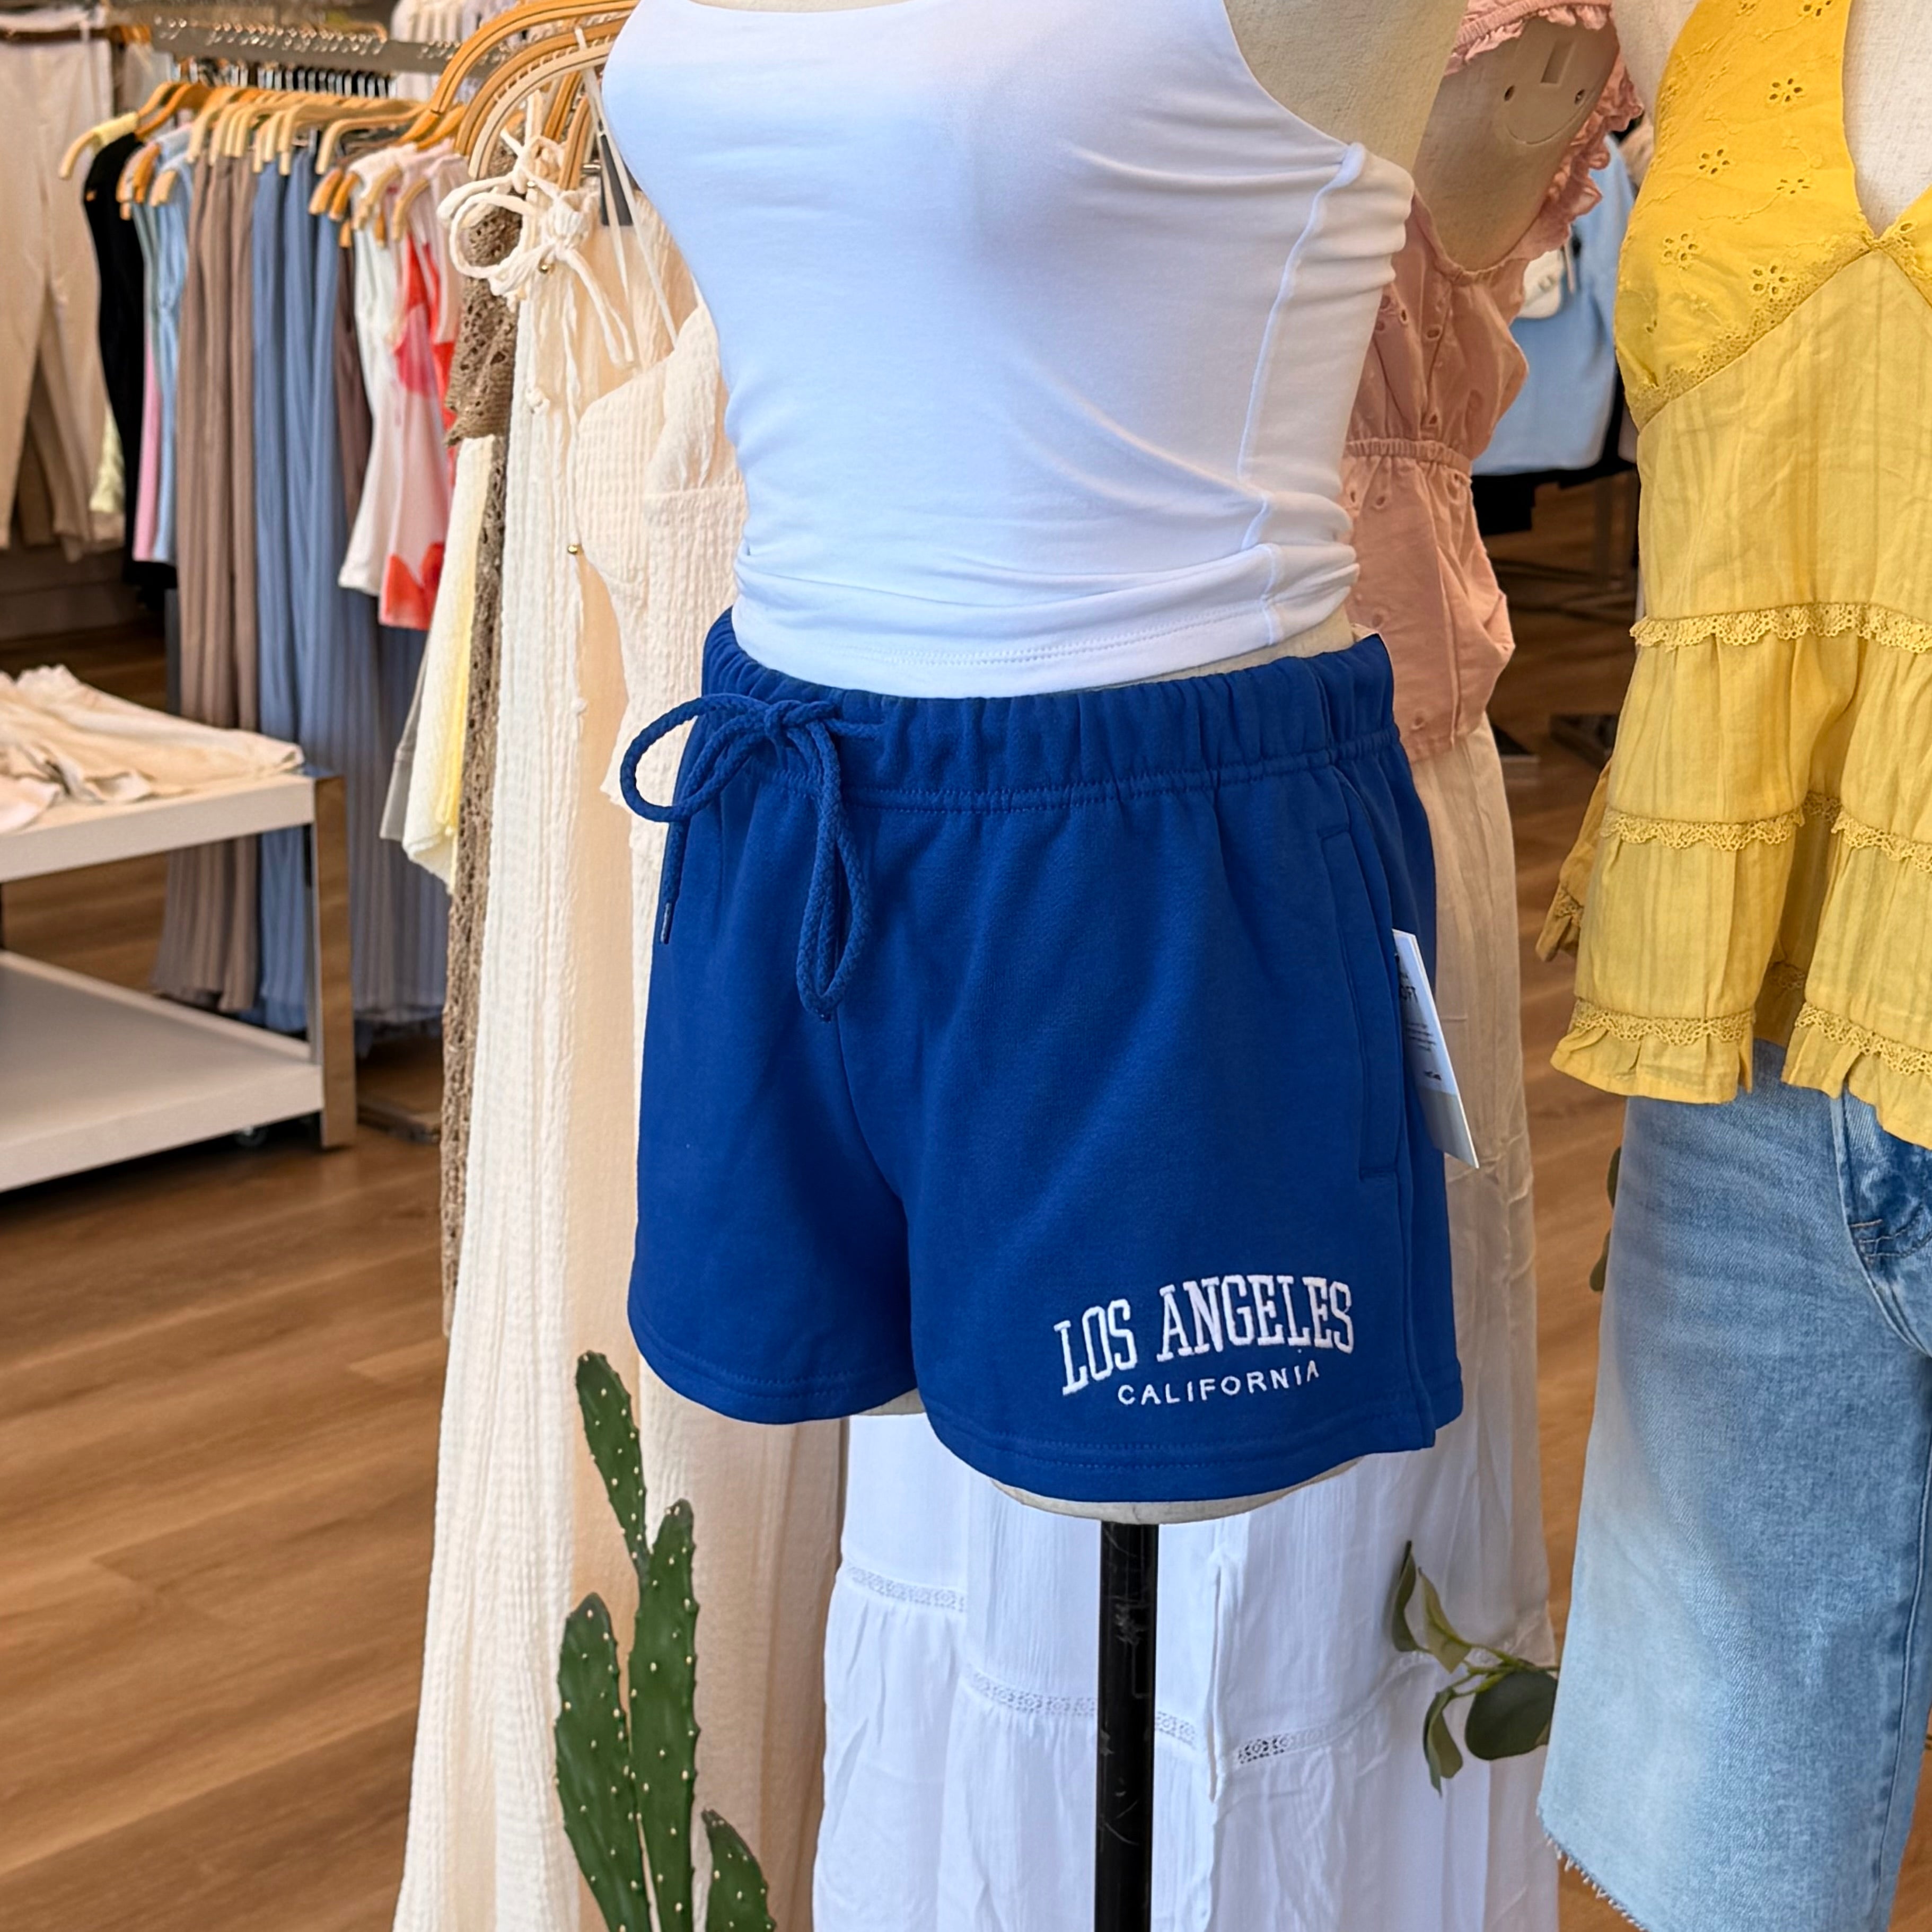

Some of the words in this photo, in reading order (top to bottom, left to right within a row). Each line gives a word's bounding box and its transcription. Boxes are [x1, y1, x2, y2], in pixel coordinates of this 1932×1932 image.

[1054, 1298, 1137, 1395] LOS
[1156, 1275, 1354, 1362] ANGELES
[1118, 1360, 1319, 1405] CALIFORNIA
